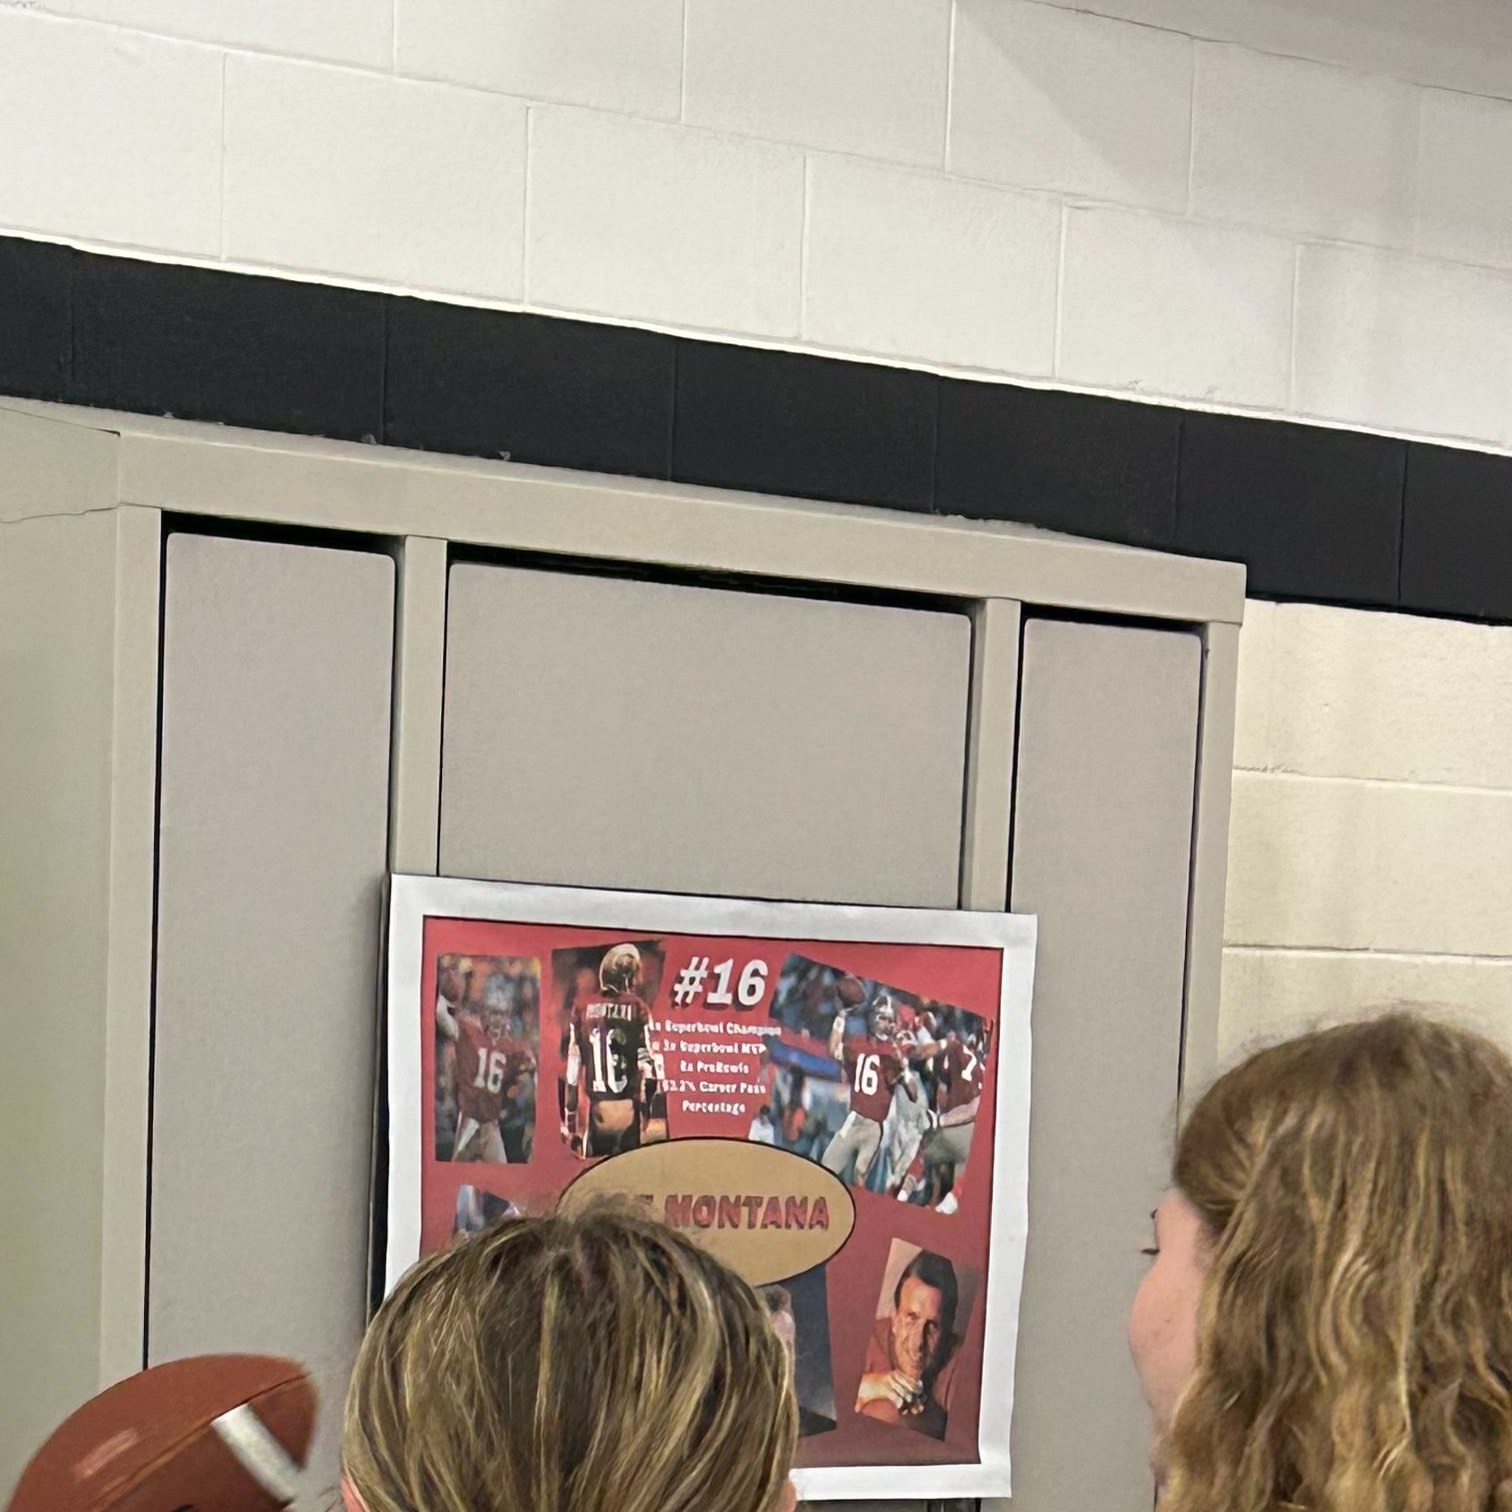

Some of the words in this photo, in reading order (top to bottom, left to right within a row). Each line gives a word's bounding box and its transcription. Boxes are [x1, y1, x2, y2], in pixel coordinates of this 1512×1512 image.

[672, 956, 769, 1007] #16
[854, 1053, 881, 1096] 16
[681, 1100, 746, 1115] Percentage
[663, 1193, 830, 1230] MONTANA
